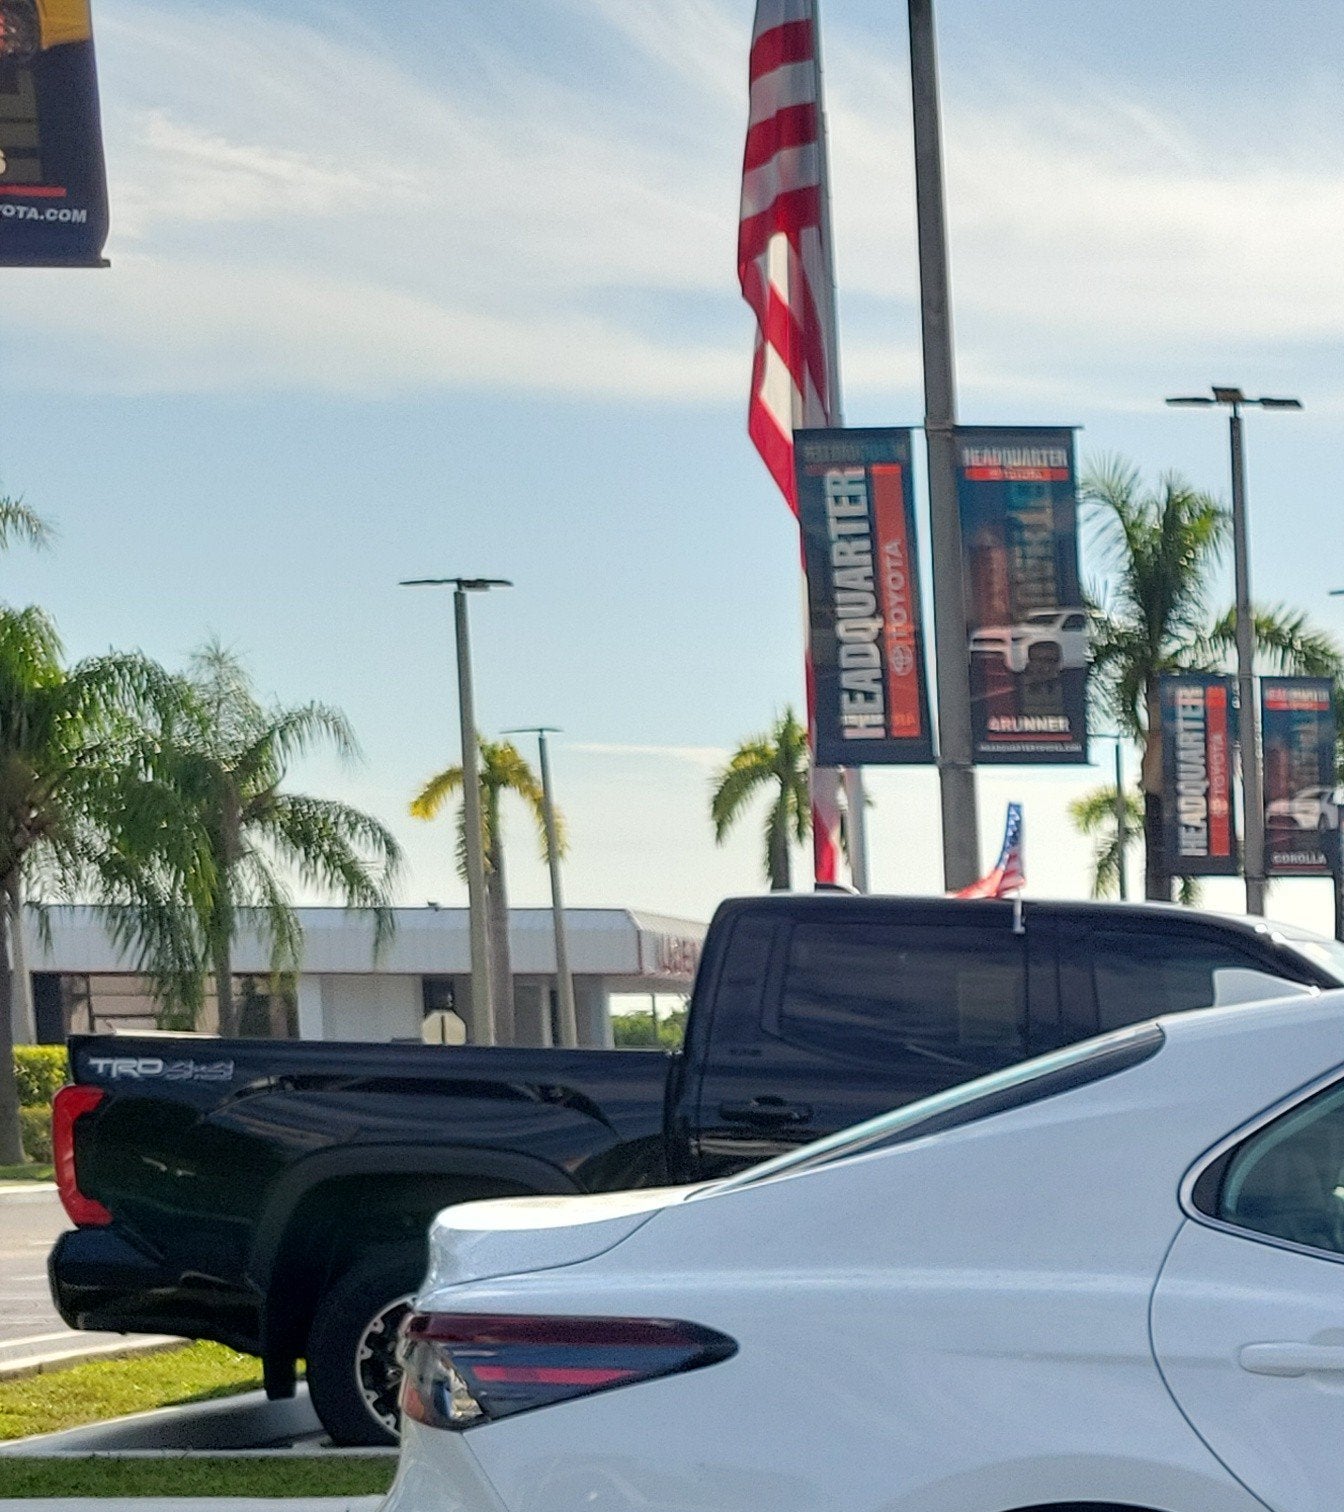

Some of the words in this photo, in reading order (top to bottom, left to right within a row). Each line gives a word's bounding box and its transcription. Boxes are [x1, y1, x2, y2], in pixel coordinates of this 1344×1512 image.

[962, 446, 1068, 468] HEADQUARTER
[884, 539, 913, 639] TOYOTA
[823, 466, 886, 739] HEADQUARTER
[987, 715, 1070, 732] 4RUNNER
[1175, 686, 1209, 856] HEADQUARTER
[1273, 850, 1327, 864] COROLLA
[89, 1057, 164, 1079] TRD
